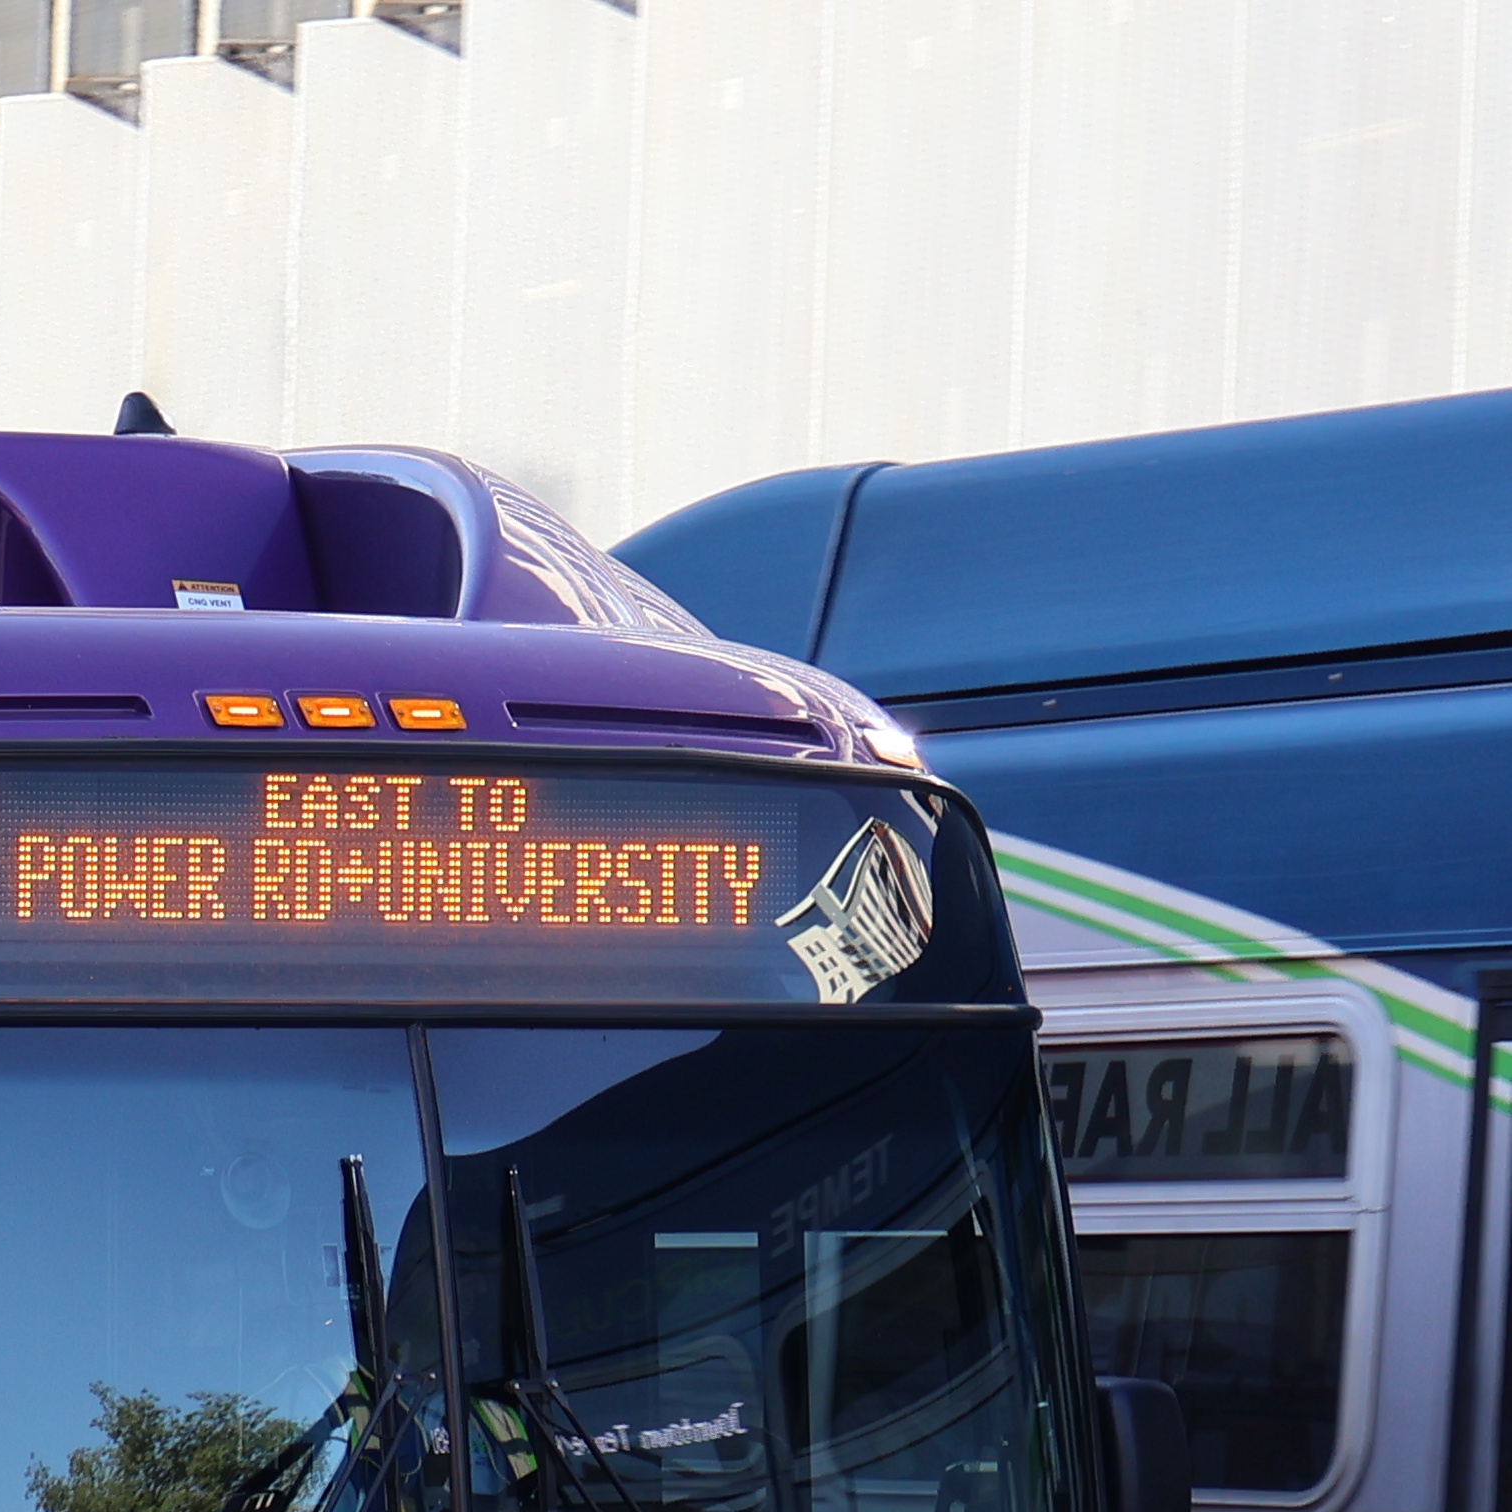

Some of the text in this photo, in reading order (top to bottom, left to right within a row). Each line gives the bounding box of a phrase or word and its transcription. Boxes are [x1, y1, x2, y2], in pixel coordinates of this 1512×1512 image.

[187, 597, 232, 608] CNG VENT
[190, 583, 235, 593] ATTENTION
[263, 775, 529, 834] EAST TO
[15, 835, 225, 922] POWER
